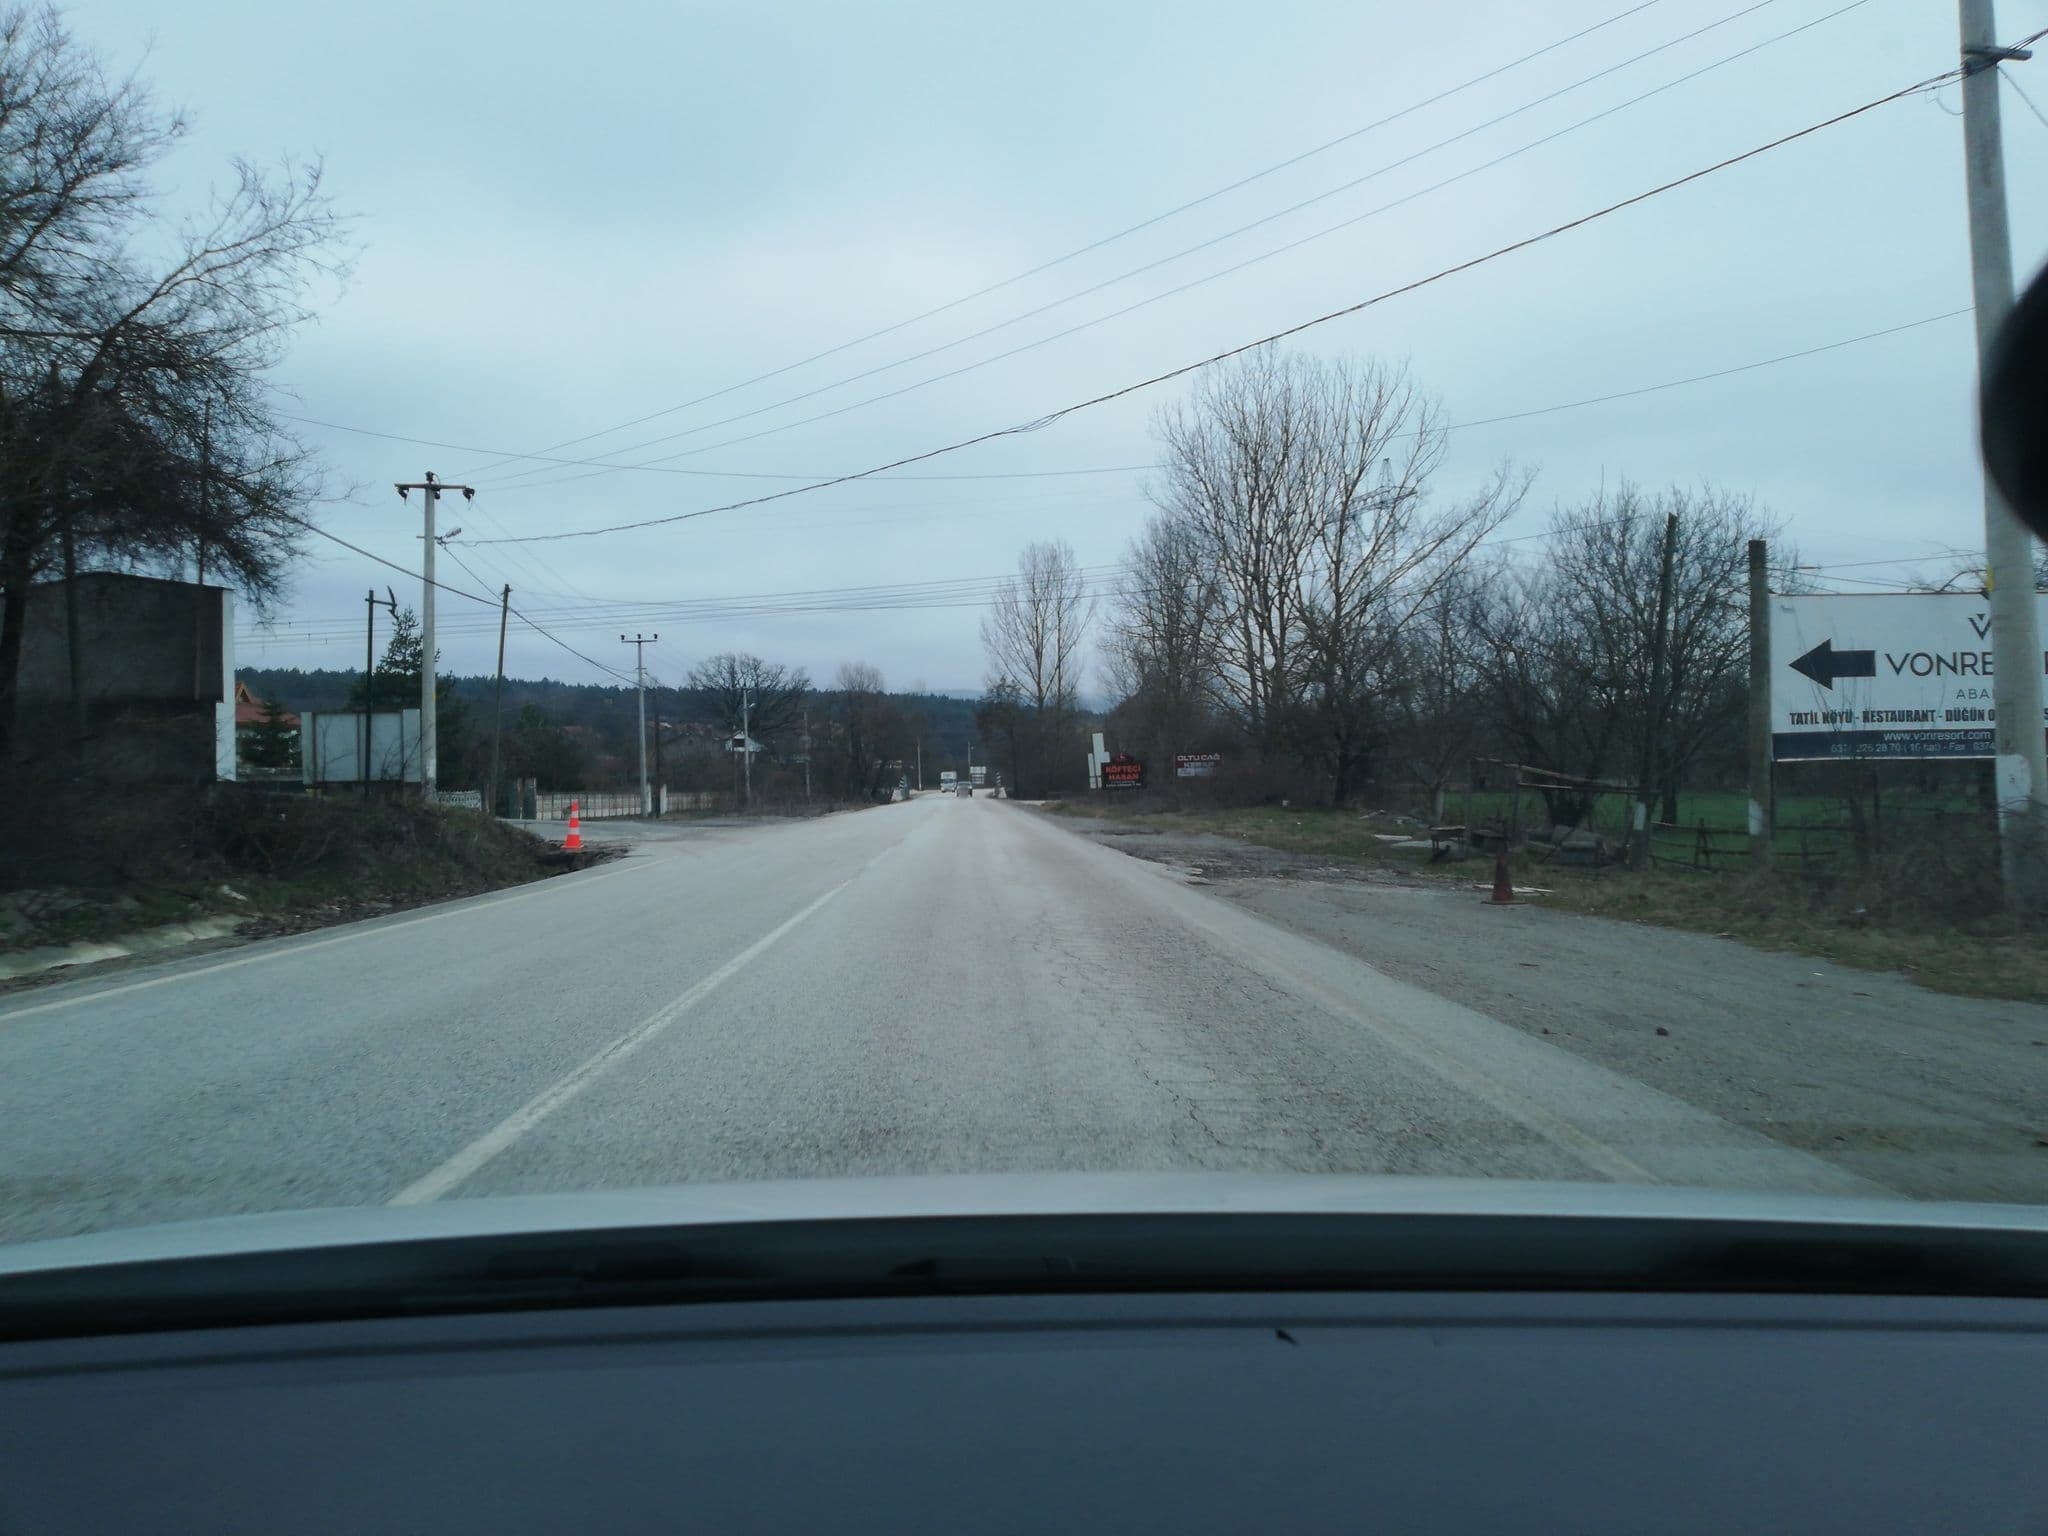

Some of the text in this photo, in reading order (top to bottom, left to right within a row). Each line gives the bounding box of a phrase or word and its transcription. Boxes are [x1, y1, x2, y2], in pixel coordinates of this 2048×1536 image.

[1884, 652, 1994, 676] VONRE
[1956, 688, 1994, 700] ABA
[1789, 710, 1820, 725] TATİL
[1862, 709, 1936, 724] RESTAURANT
[1945, 707, 1985, 722] DÜĞÜN
